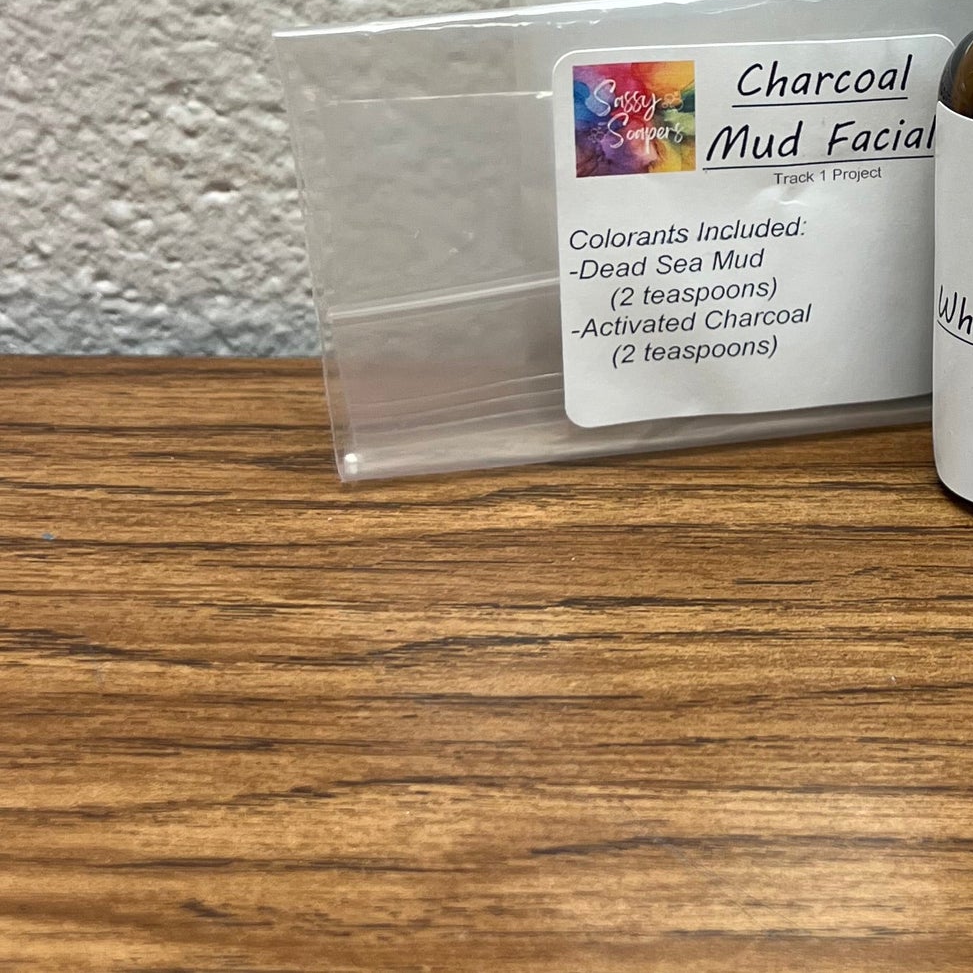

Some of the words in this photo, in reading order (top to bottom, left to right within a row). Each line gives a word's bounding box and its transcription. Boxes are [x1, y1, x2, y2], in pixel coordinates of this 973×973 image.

[737, 54, 913, 98] Charcoal
[594, 79, 662, 121] Sassy
[607, 112, 684, 155] Soapers
[706, 121, 804, 162] Mud
[827, 114, 936, 156] Facial
[774, 171, 815, 185] Track
[820, 170, 826, 182] 1
[833, 167, 882, 183] Project
[569, 224, 689, 250] Colorants
[697, 216, 807, 242] Included:
[569, 257, 647, 280] -Dead
[656, 255, 703, 275] Sea
[712, 248, 765, 271] Mud
[611, 286, 635, 312] (2
[643, 276, 778, 307] teaspoons)
[571, 312, 696, 339] -Activated
[705, 303, 812, 330] Charcoal
[612, 344, 635, 369] (2
[644, 334, 778, 364] teaspoons)
